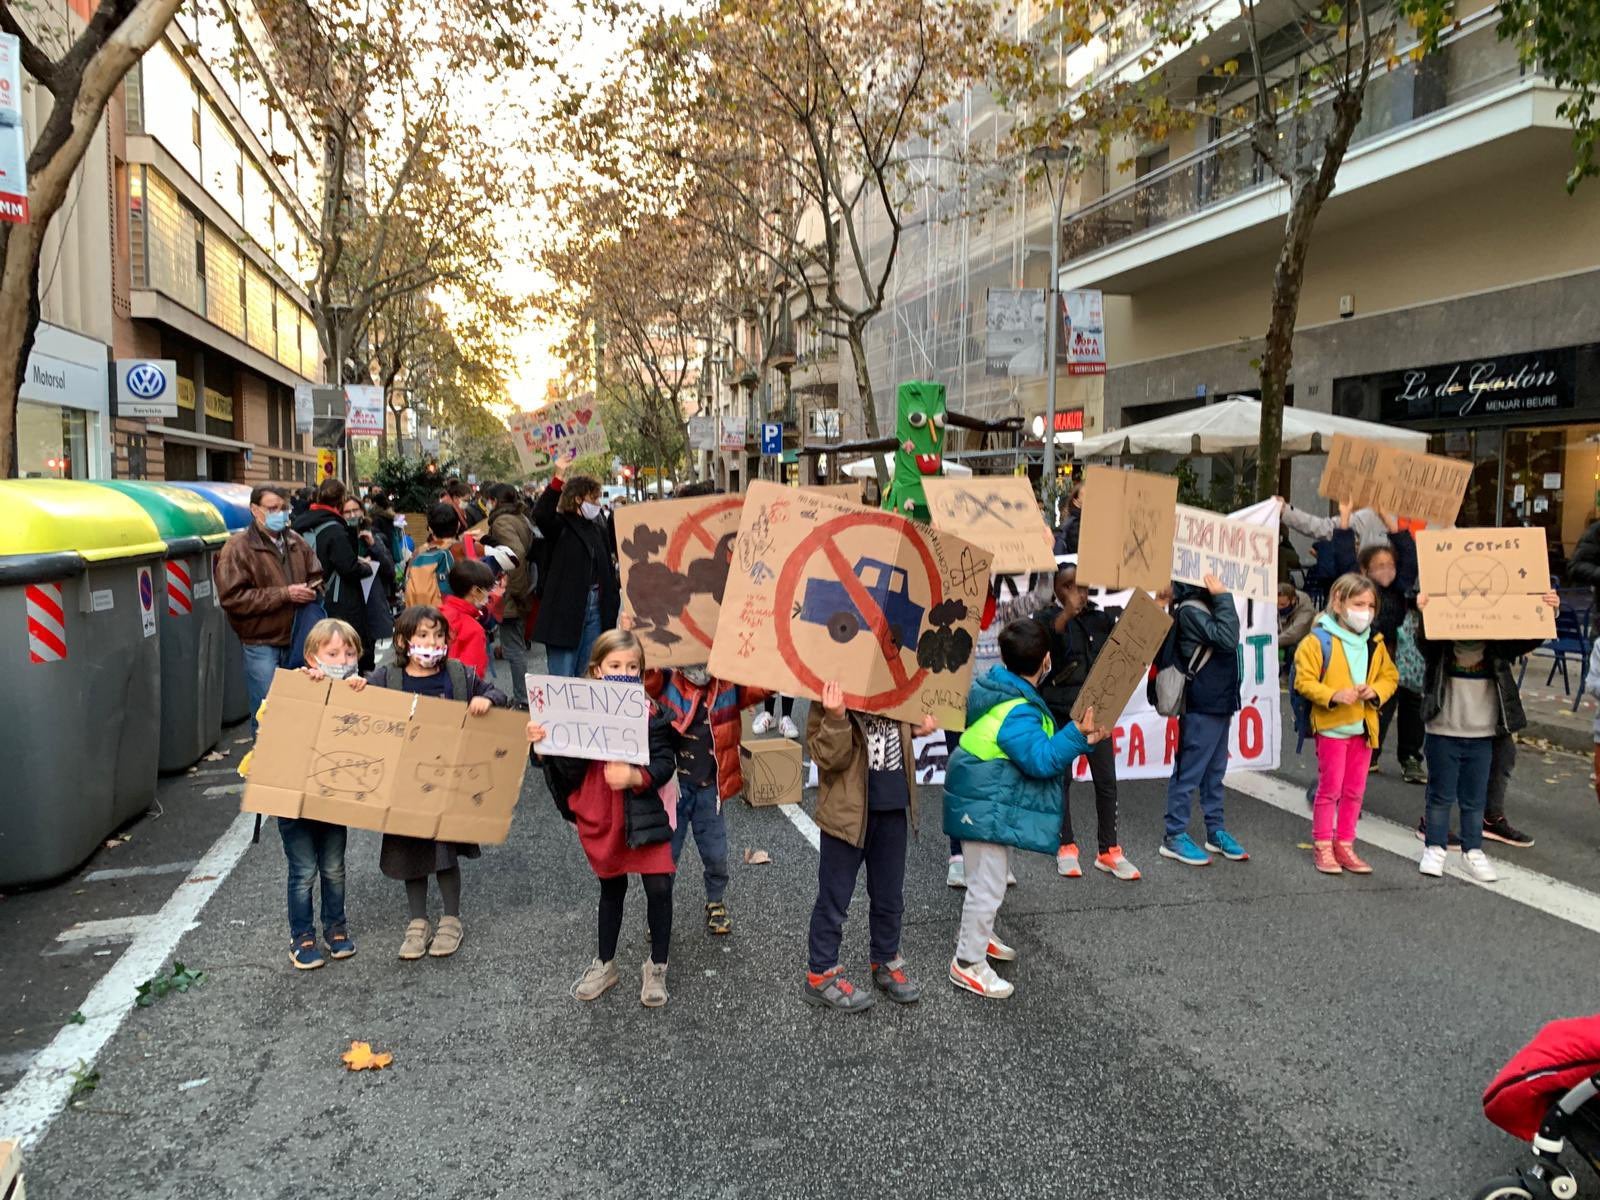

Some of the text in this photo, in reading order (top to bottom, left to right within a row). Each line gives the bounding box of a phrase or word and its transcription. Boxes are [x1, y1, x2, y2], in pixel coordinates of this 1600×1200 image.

[33, 364, 66, 391] Motorsol
[1395, 361, 1557, 417] Lo de Gastón
[1486, 398, 1521, 411] MENJAR
[1526, 395, 1558, 409] BEURE
[765, 425, 778, 442] P
[1435, 541, 1453, 553] NO
[546, 682, 644, 719] MENYS
